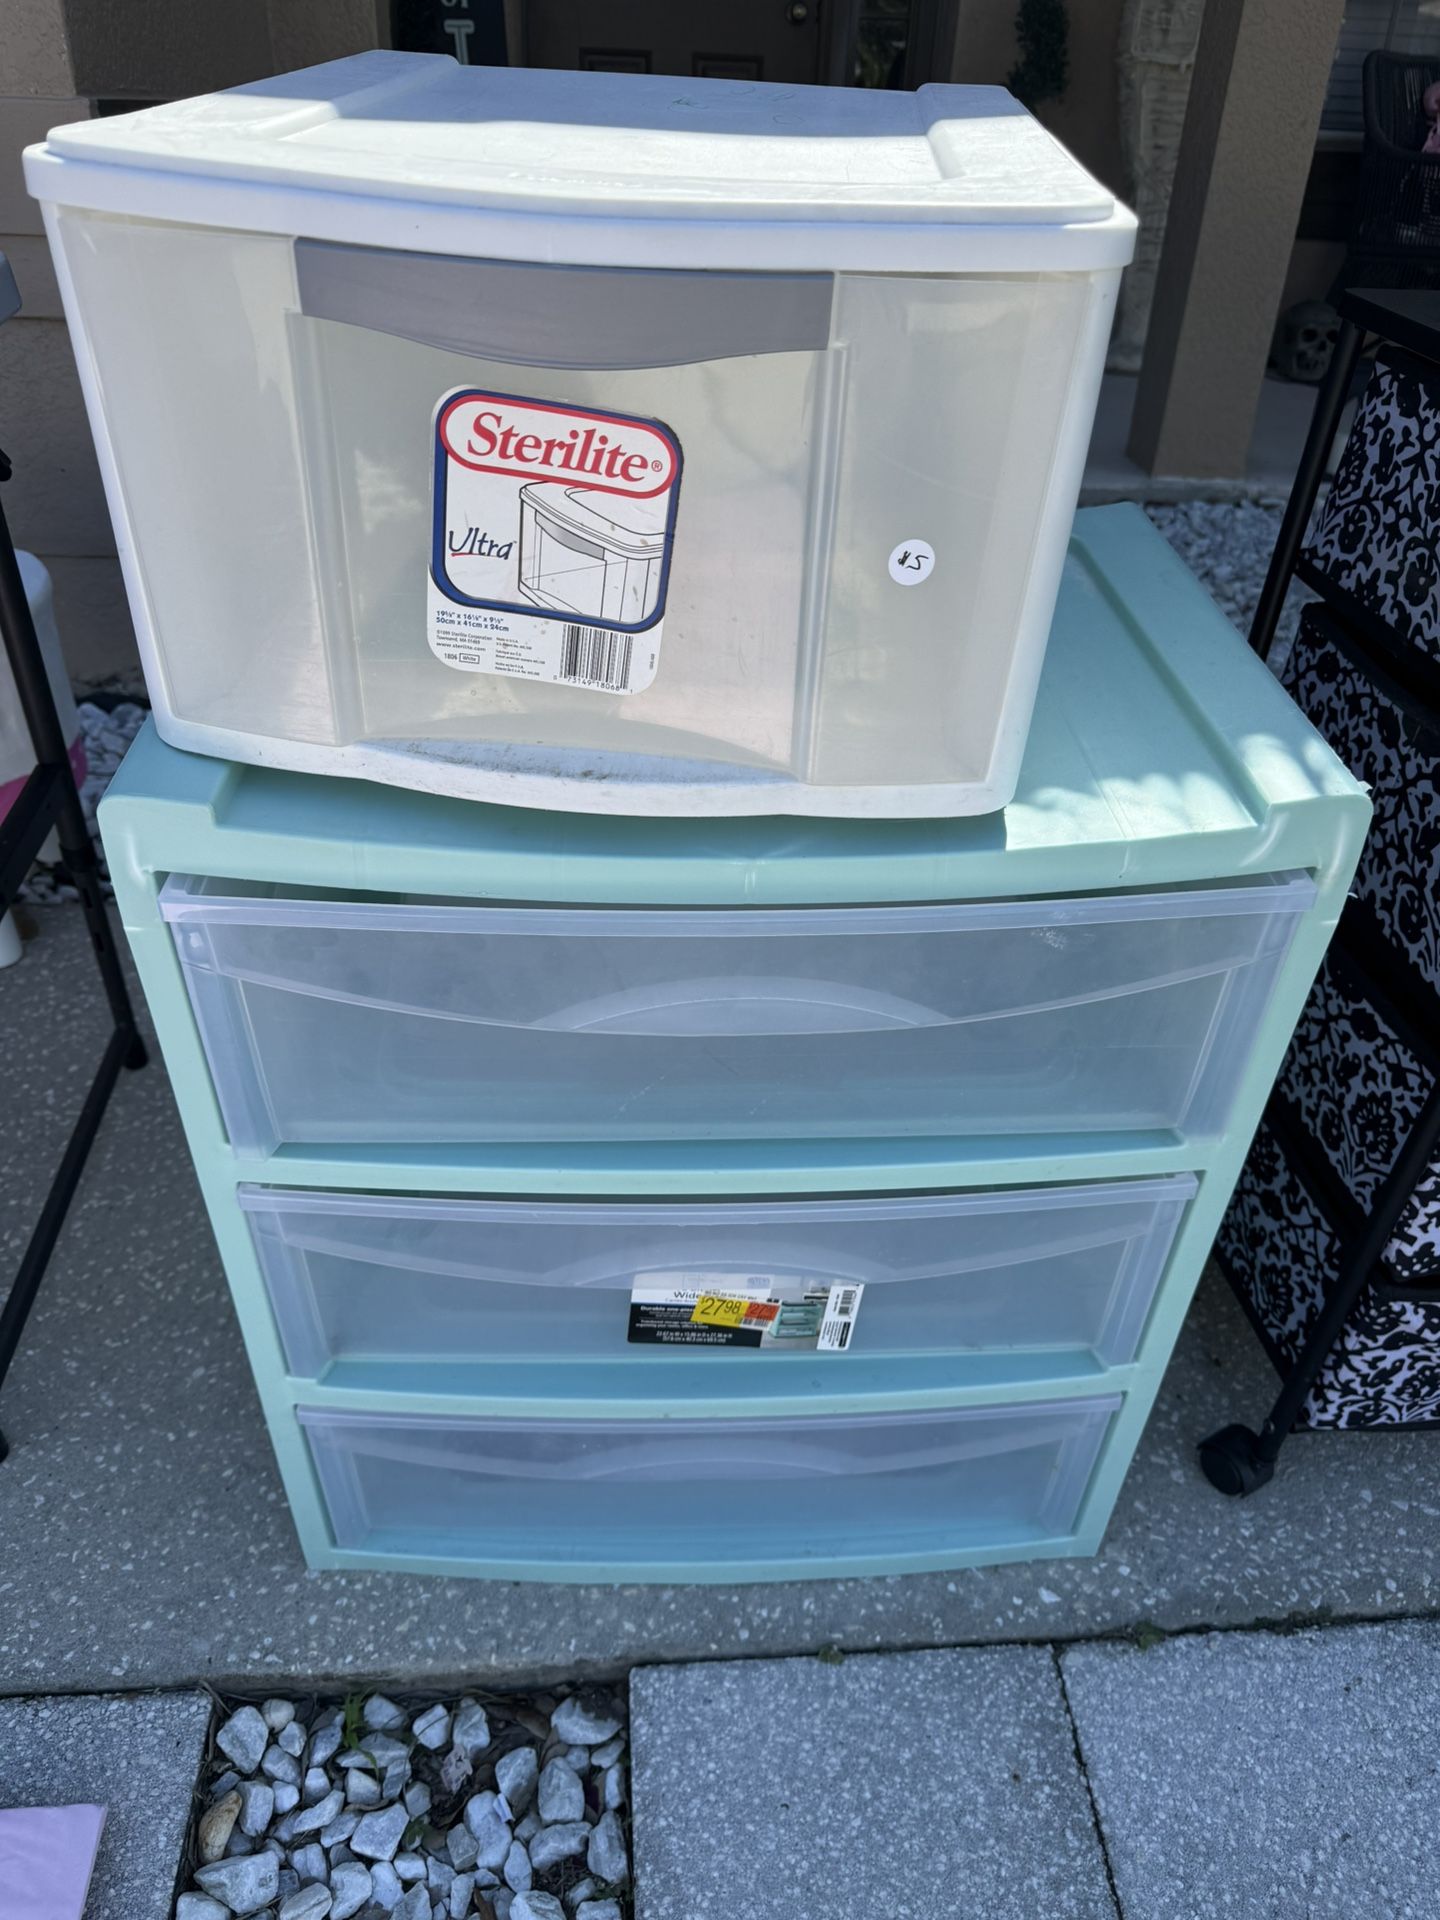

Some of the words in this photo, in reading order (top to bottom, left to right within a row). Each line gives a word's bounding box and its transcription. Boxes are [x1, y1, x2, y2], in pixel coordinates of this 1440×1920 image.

[436, 616, 456, 625] 50cm
[463, 620, 483, 628] 41cm
[489, 623, 509, 632] 24cm
